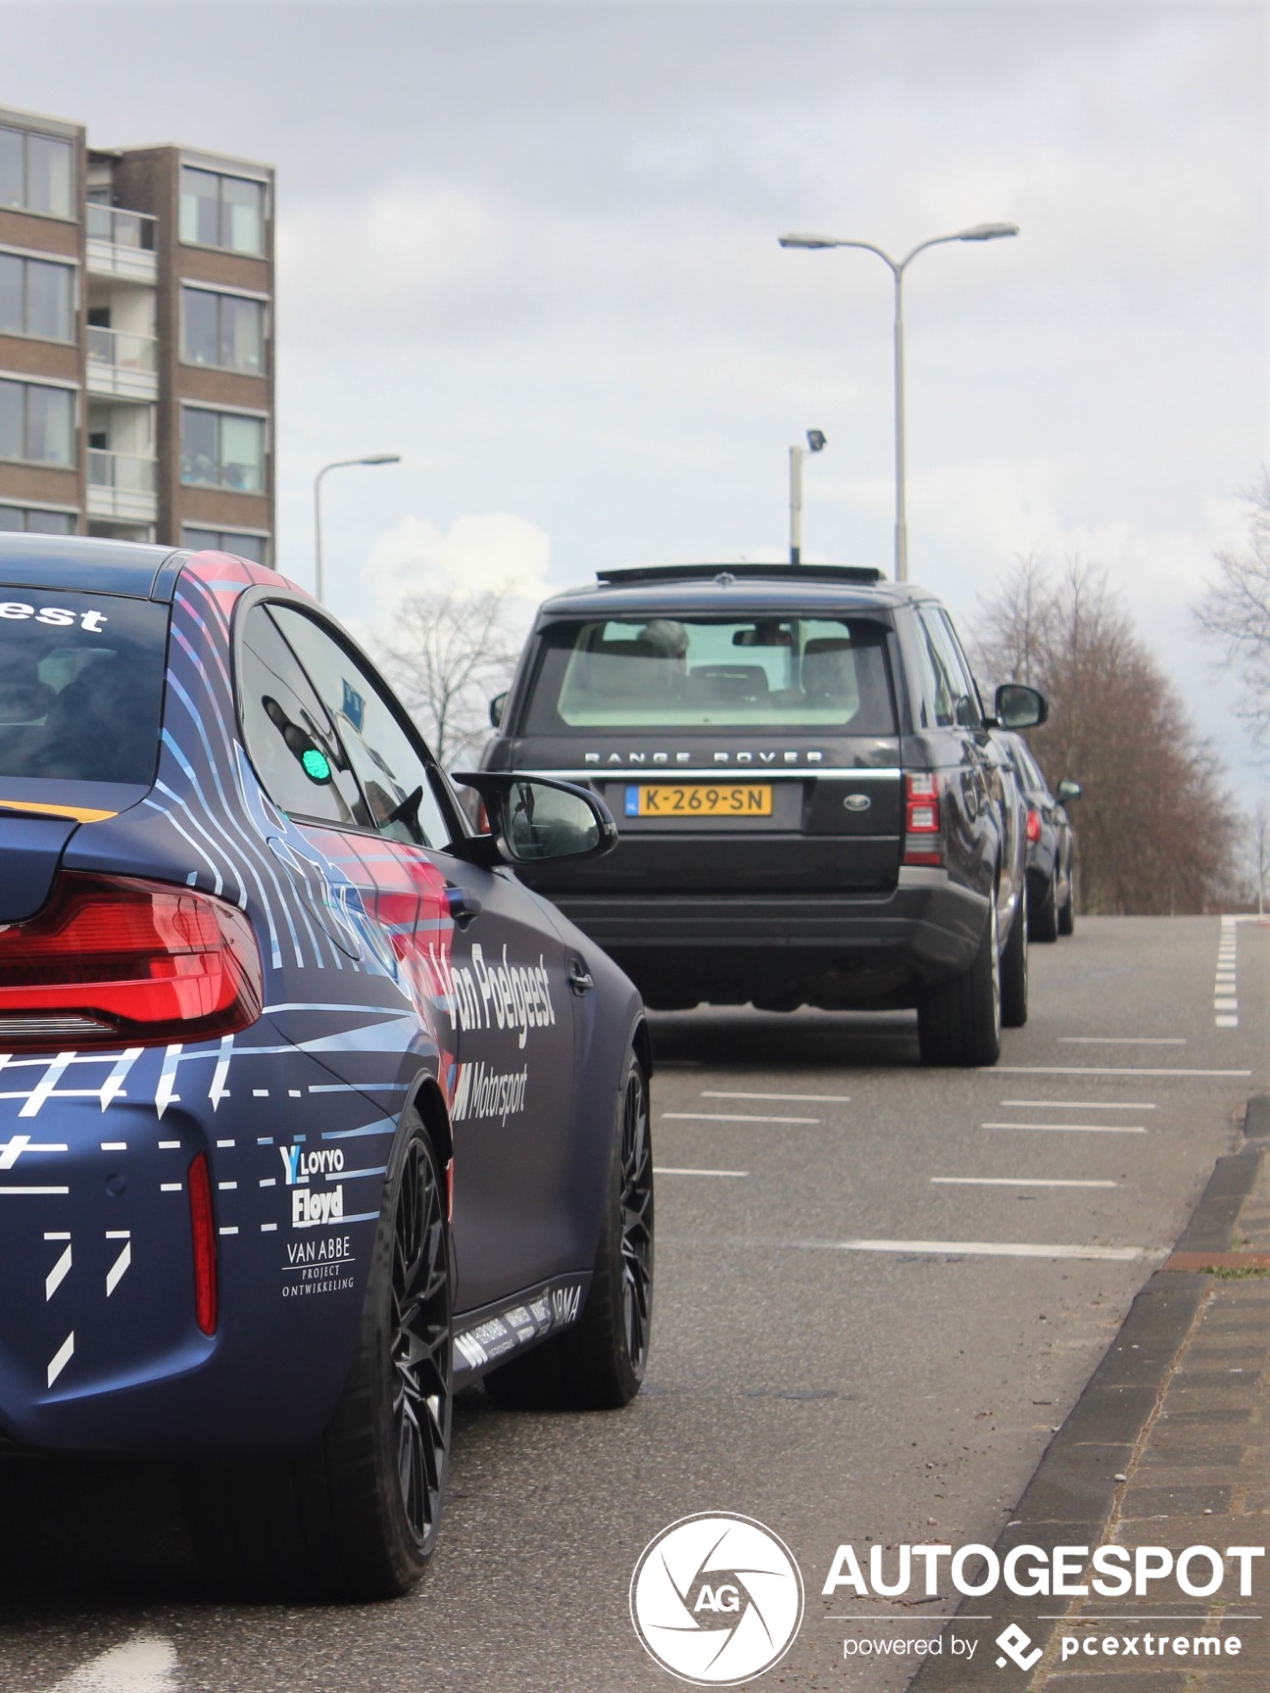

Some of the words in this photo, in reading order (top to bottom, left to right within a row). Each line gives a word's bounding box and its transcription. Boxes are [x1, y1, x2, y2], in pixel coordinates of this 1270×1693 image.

[585, 752, 691, 763] RANGE
[714, 751, 823, 763] ROVER
[646, 788, 763, 810] K-269-SN
[429, 942, 481, 1031] Van
[471, 942, 555, 1049] Poelgeest
[468, 1061, 527, 1128] Motorsport
[292, 1185, 343, 1225] Floyd
[287, 1241, 316, 1263] VAN
[318, 1236, 350, 1260] ABBE
[302, 1265, 340, 1280] PROJECT
[282, 1277, 354, 1297] ONTWIKKELING
